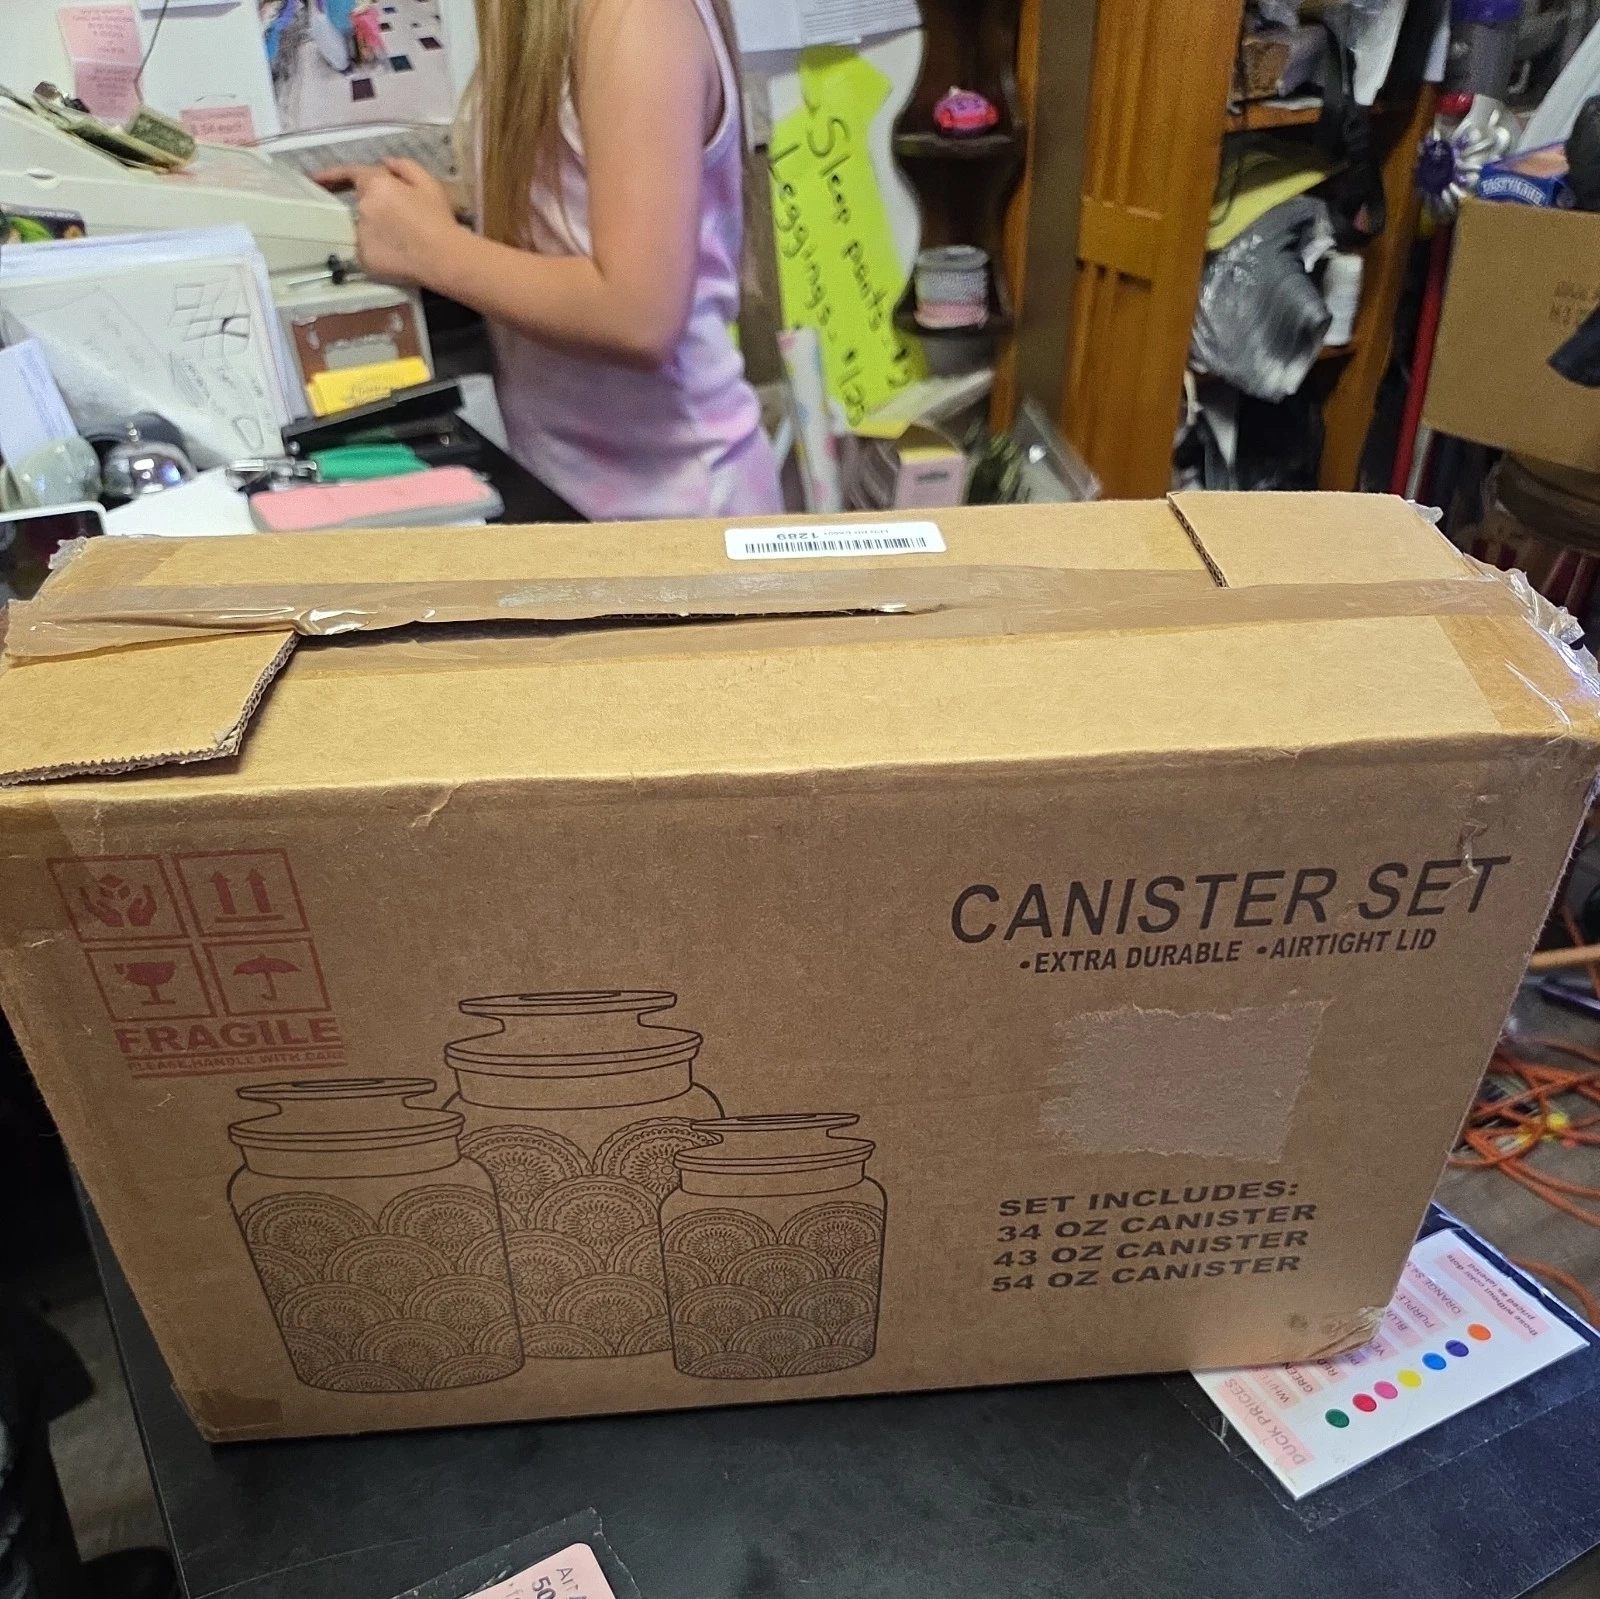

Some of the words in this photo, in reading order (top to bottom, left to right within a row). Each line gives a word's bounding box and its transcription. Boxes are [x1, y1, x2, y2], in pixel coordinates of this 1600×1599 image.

[841, 239, 889, 332] pants
[776, 532, 820, 541] 1289
[951, 868, 1336, 943] CANISTER
[1358, 855, 1511, 920] SET
[1125, 940, 1243, 969] DURABLE
[1396, 926, 1437, 951] LID
[114, 1017, 342, 1053] FRAGILE
[191, 1055, 253, 1069] HANDLE
[259, 1052, 301, 1064] WITH
[998, 1195, 1076, 1217] SET
[1088, 1180, 1299, 1211] INCLUDES:
[996, 1223, 1042, 1243] 34
[1055, 1218, 1109, 1238] OZ
[1120, 1203, 1317, 1234] CANISTER
[992, 1249, 1038, 1268] 43
[1051, 1245, 1104, 1264] OZ
[1115, 1229, 1310, 1260] CANISTER
[991, 1274, 1035, 1293] 54
[1047, 1269, 1100, 1289] OZ
[1111, 1255, 1301, 1284] CANISTER
[1397, 1293, 1435, 1329] PURPLE
[1425, 1278, 1461, 1315] ORANGE
[1483, 1287, 1514, 1315] without
[1514, 1314, 1538, 1337] those
[1281, 1361, 1314, 1394] GREEN
[1224, 1378, 1272, 1426] PRICES
[1269, 1425, 1306, 1466] DUCK
